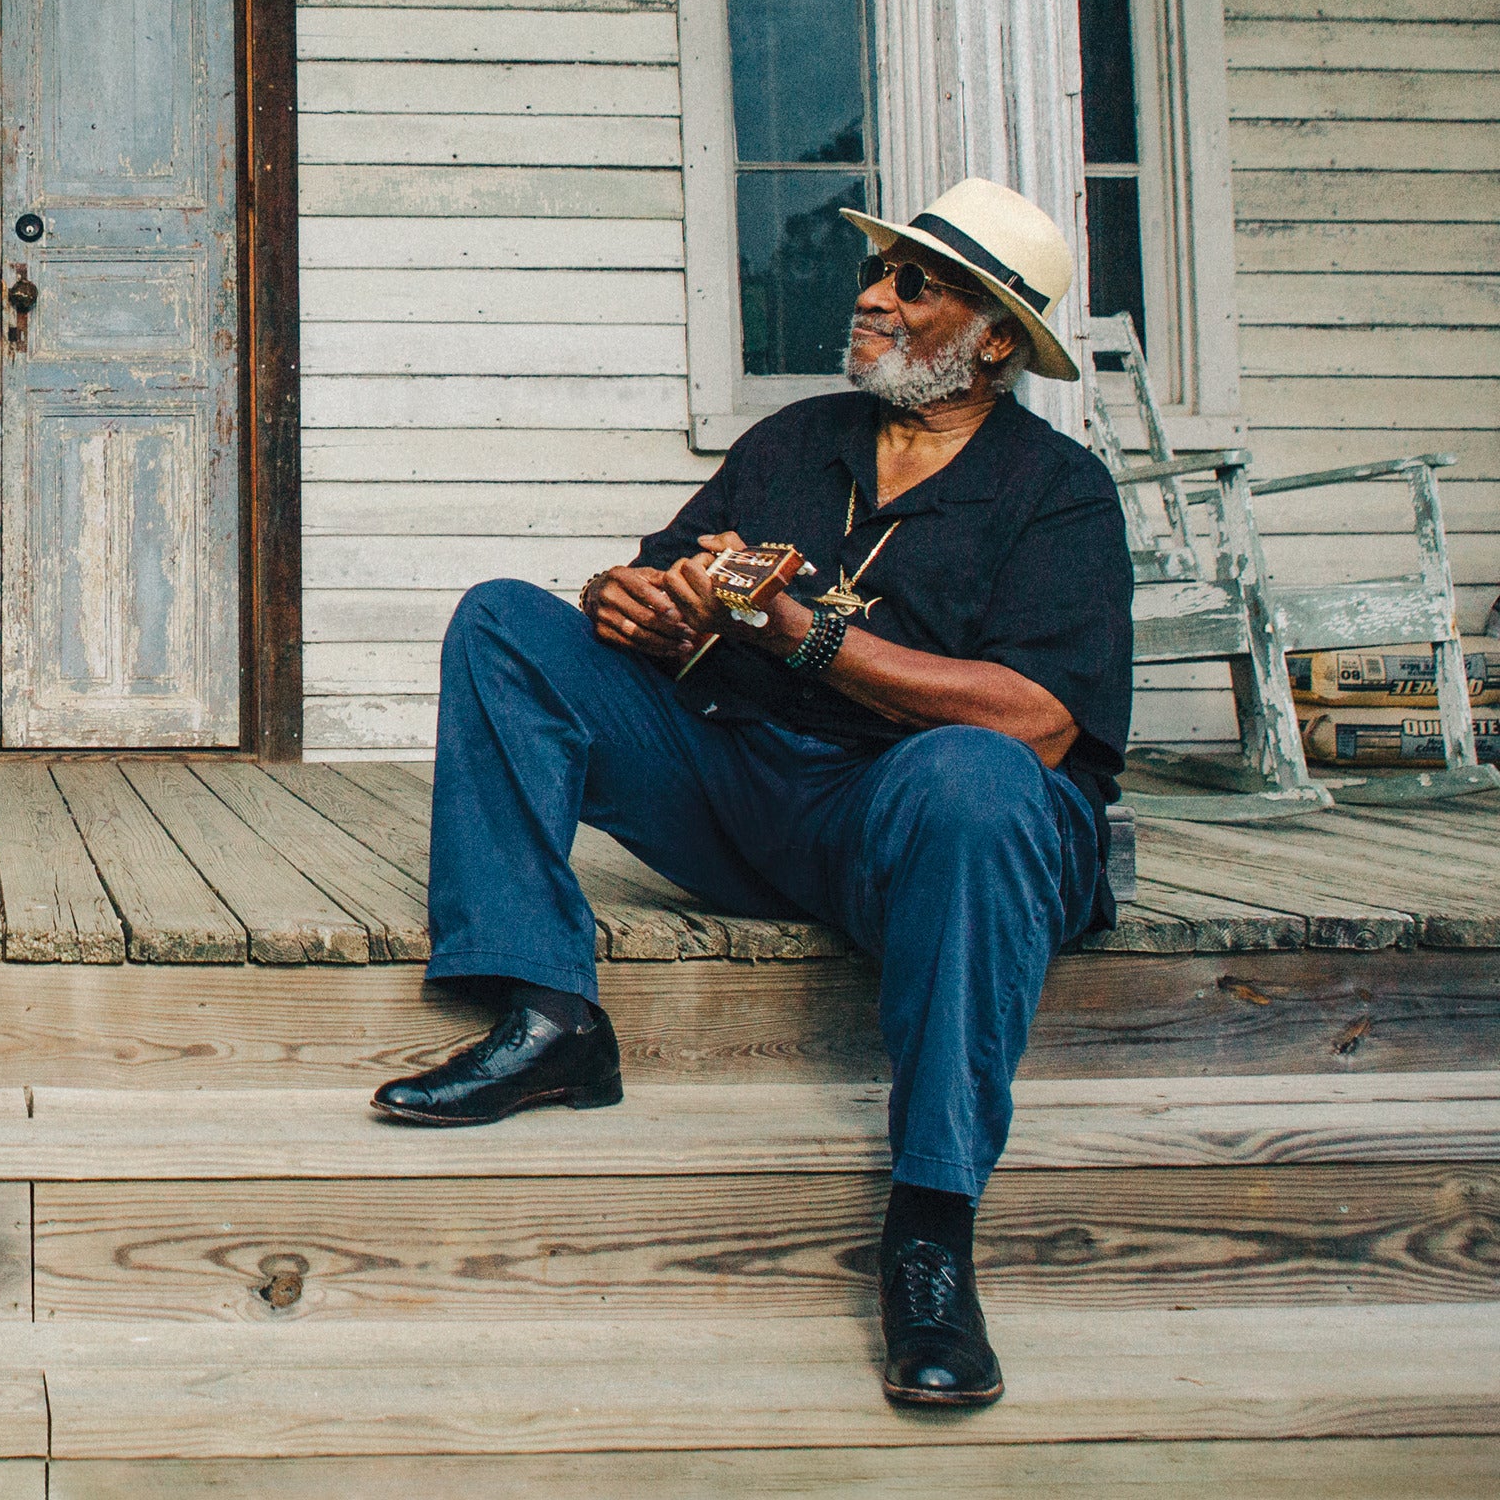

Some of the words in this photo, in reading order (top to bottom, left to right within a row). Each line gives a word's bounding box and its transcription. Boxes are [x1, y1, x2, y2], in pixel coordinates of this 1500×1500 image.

[1341, 670, 1361, 681] 80
[1390, 679, 1484, 696] QRETE
[1402, 719, 1499, 736] QUITE
